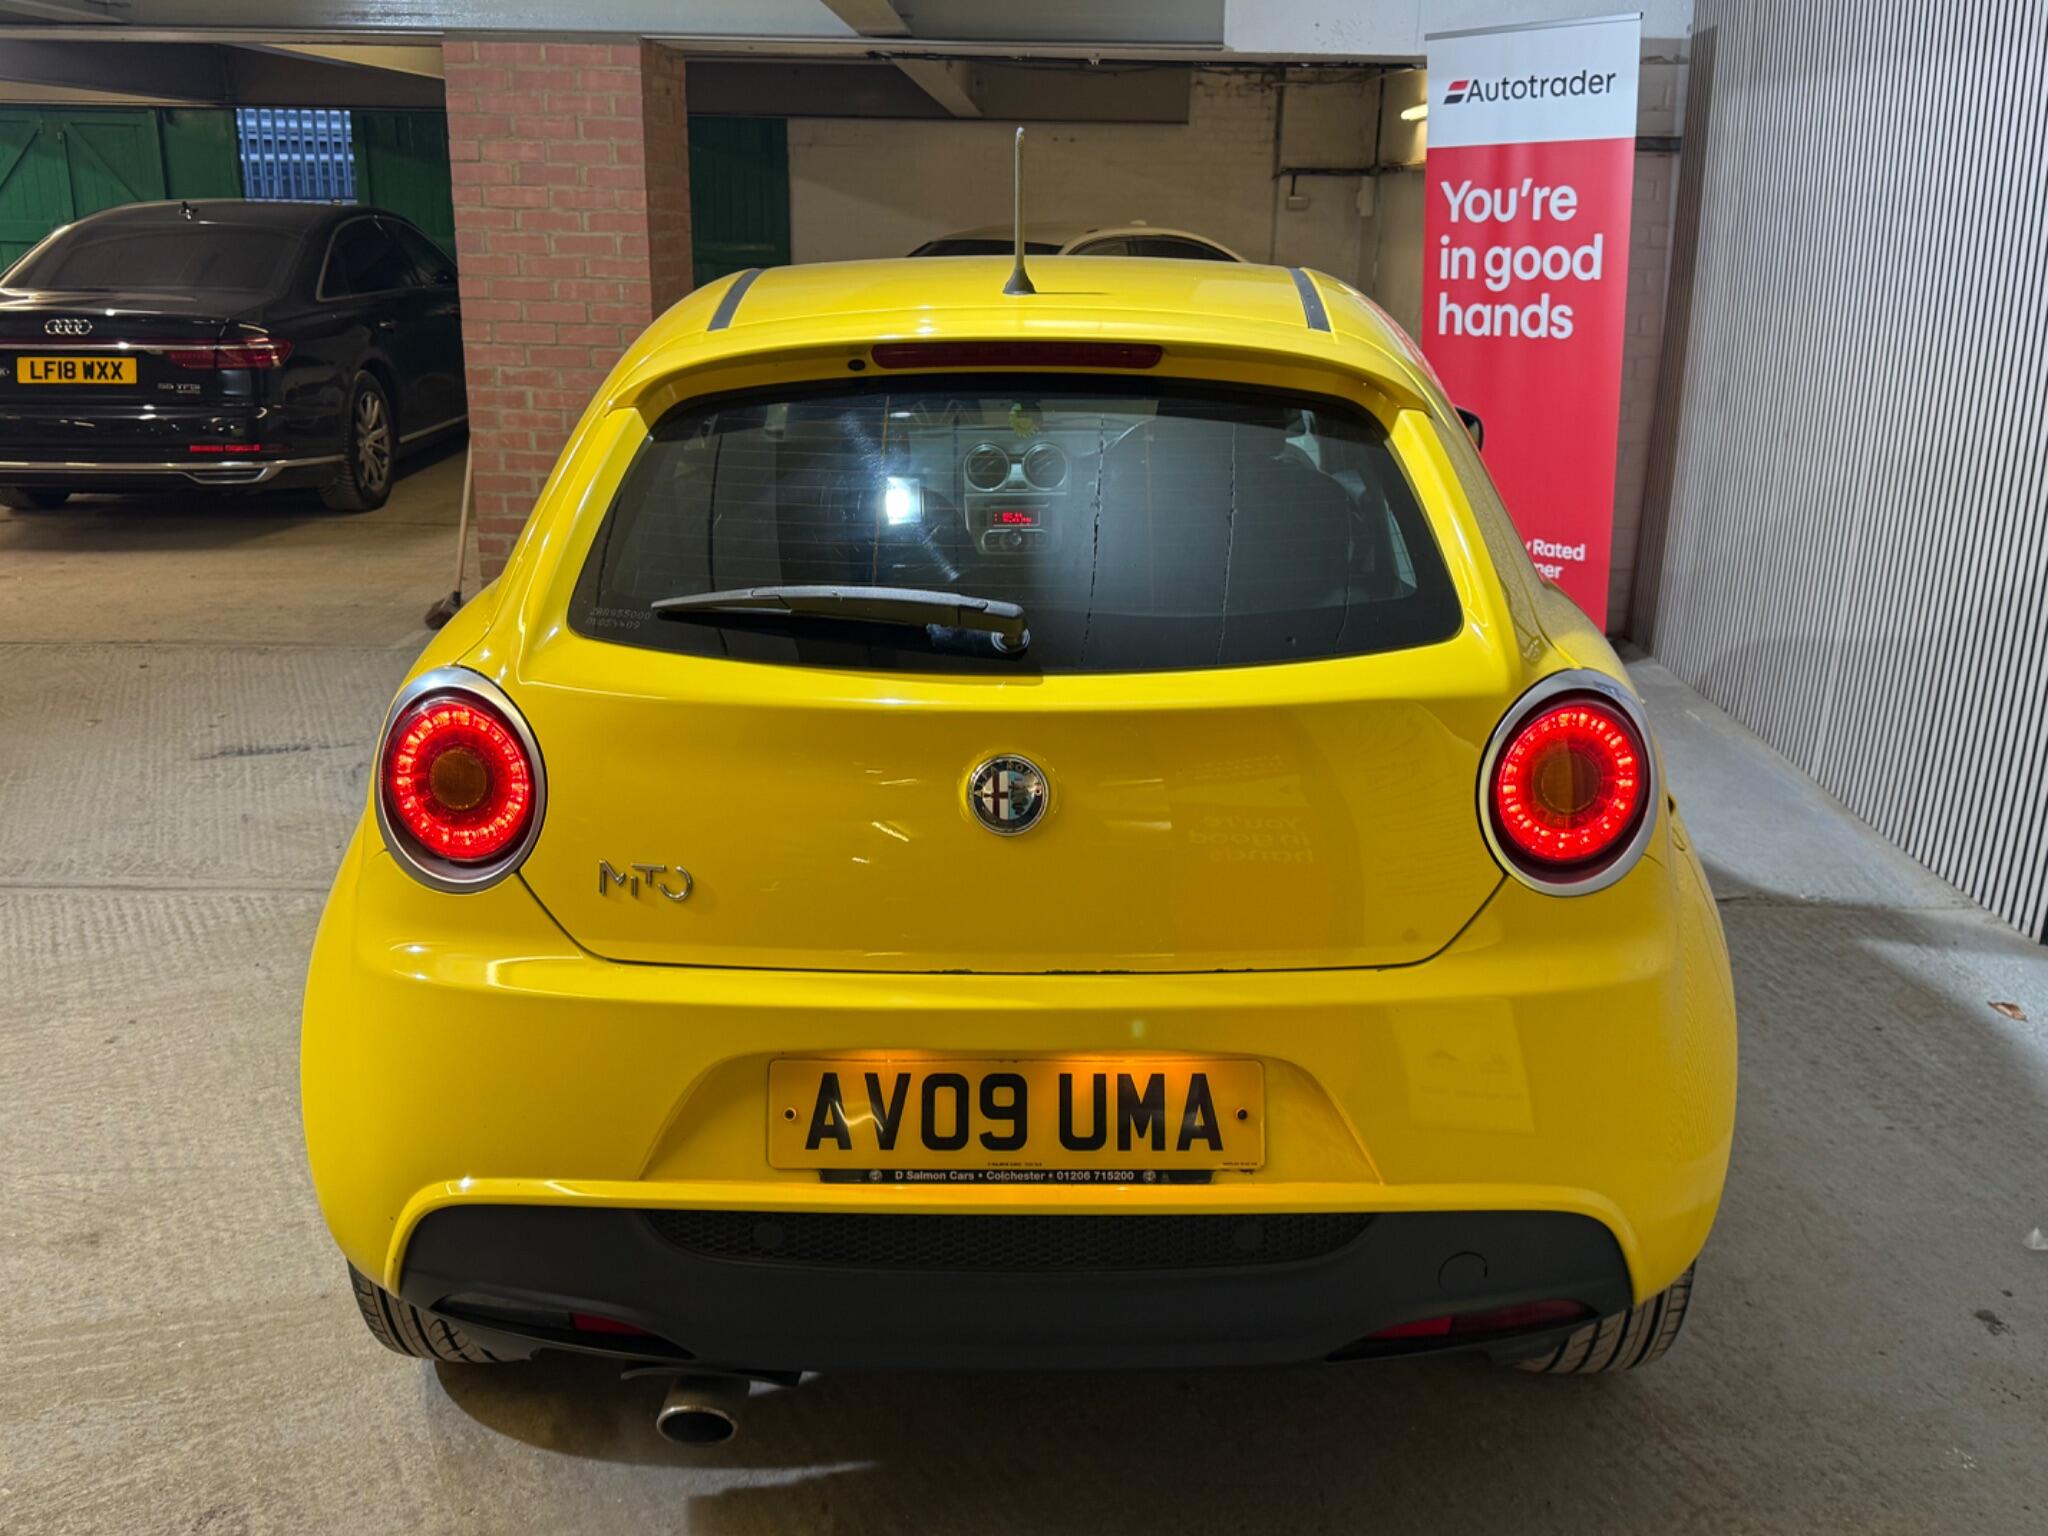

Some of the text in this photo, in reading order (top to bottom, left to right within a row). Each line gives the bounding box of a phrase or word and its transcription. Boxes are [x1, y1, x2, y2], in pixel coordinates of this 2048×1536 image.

[1466, 70, 1616, 103] Autotrader
[1440, 178, 1578, 223] You’re
[1439, 233, 1604, 292] in good
[1437, 291, 1574, 340] hands
[30, 361, 76, 380] LF18
[82, 361, 123, 380] WXX
[1532, 539, 1585, 561] Rated
[805, 1072, 1224, 1152] AV09 UMA
[895, 1171, 1135, 1181] D Salmon Cars Colchester 01206 715200
